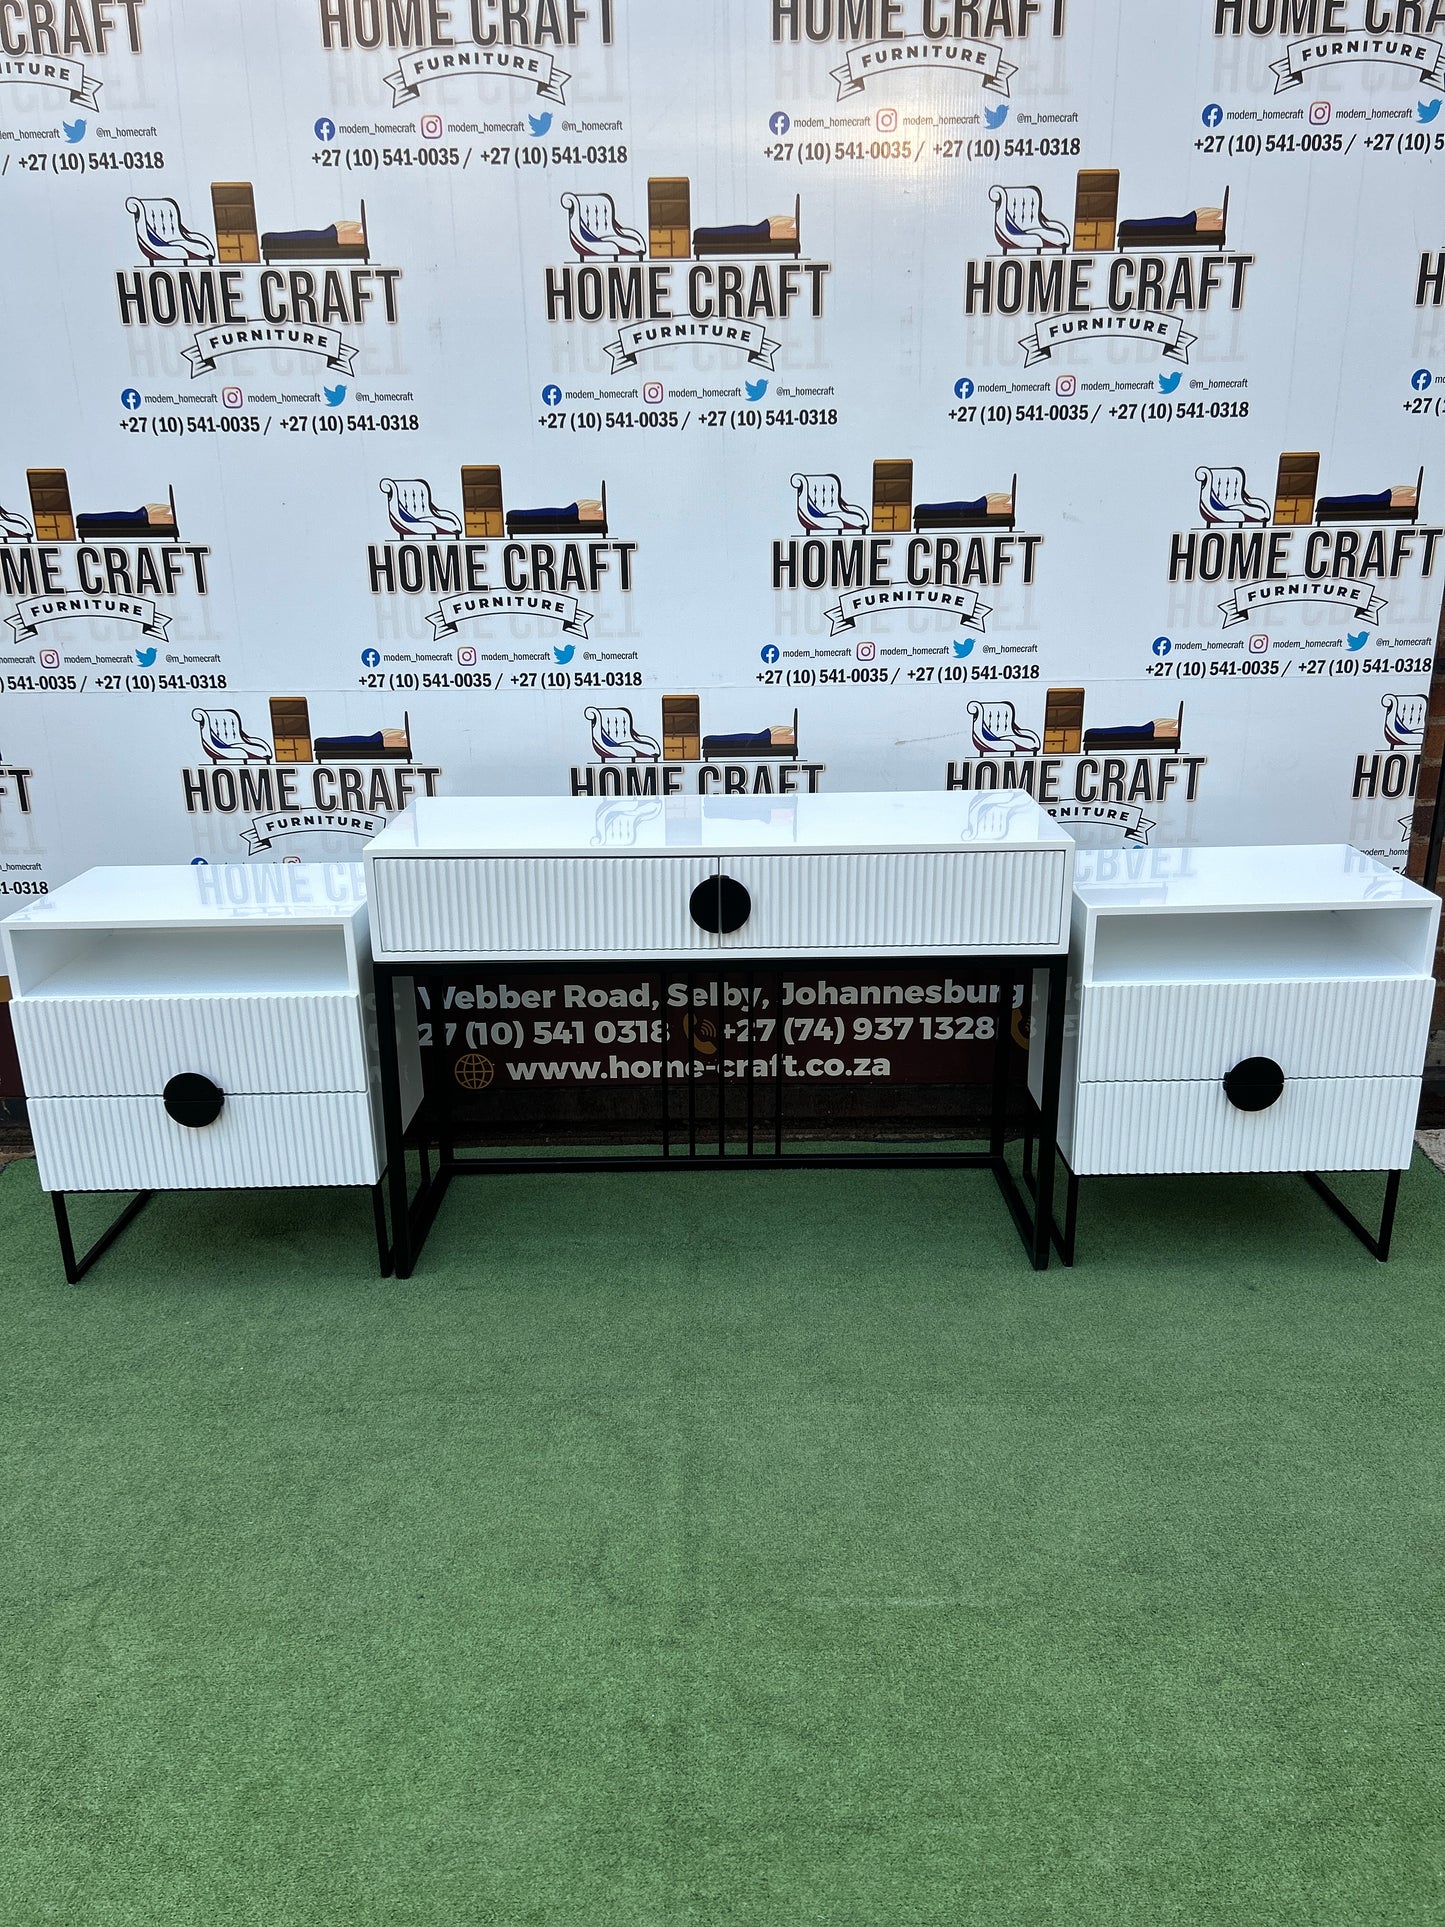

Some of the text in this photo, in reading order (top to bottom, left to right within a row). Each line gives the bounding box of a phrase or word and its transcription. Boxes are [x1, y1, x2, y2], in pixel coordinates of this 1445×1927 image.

[0, 0, 142, 55] CRAFT
[320, 0, 453, 47] HOME
[773, 0, 903, 40] HOME
[1215, 0, 1344, 34] HOME
[861, 44, 987, 68] FURNITURE
[1302, 40, 1427, 62] FURNITURE
[413, 52, 540, 73] FURNITURE
[562, 120, 623, 133] @m_homecraft
[1017, 112, 1078, 125] @m_homecraft
[96, 127, 157, 139] @m_homecraft
[764, 144, 793, 161] +27
[798, 143, 830, 164] (10)
[933, 140, 963, 157] +27
[967, 140, 1000, 161] (10)
[1004, 138, 1080, 156] 541-0318
[1195, 136, 1225, 152] +27
[1229, 135, 1261, 156] (10)
[1364, 134, 1394, 150] +27
[1398, 134, 1430, 154] (10)
[19, 154, 47, 170] +27
[52, 153, 85, 174] (10)
[89, 152, 164, 169] 541-0318
[312, 149, 341, 166] +27
[346, 149, 378, 170] (10)
[481, 147, 510, 164] +27
[515, 147, 547, 168] (10)
[552, 146, 627, 164] 541-0318
[546, 265, 828, 319] HOME CRAFT
[966, 256, 1252, 313] HOME CRAFT
[117, 270, 399, 324] HOME CRAFT
[633, 321, 752, 344] FURNITURE
[1049, 316, 1168, 338] FURNITURE
[209, 328, 329, 349] FURNITURE
[777, 386, 834, 397] @m_homecraft
[1190, 379, 1247, 390] @m_homecraft
[356, 392, 413, 403] @m_homecraft
[1403, 398, 1432, 413] +27
[539, 413, 566, 428] +27
[571, 413, 601, 432] (10)
[699, 411, 726, 426] +27
[731, 411, 761, 429] (10)
[766, 409, 837, 425] 541-0318
[949, 407, 976, 422] +27
[981, 406, 1011, 425] (10)
[1109, 404, 1137, 419] +27
[1141, 403, 1172, 422] (10)
[1176, 402, 1248, 418] 541-0318
[120, 417, 147, 432] +27
[152, 417, 183, 436] (10)
[280, 416, 307, 431] +27
[312, 416, 343, 435] (10)
[348, 415, 419, 431] 541-0318
[774, 537, 1041, 587] HOME CRAFT
[1169, 529, 1443, 580] HOME CRAFT
[77, 548, 208, 594] CRAFT
[368, 544, 635, 592] HOME CRAFT
[852, 591, 965, 610] FURNITURE
[1247, 584, 1361, 602] FURNITURE
[30, 599, 143, 617] FURNITURE
[452, 596, 566, 614] FURNITURE
[983, 644, 1037, 654] @m_homecraft
[1376, 637, 1431, 647] @m_homecraft
[166, 654, 221, 664] @m_homecraft
[583, 651, 638, 661] @m_homecraft
[756, 670, 782, 684] +27
[787, 670, 815, 686] (10)
[908, 667, 934, 681] +27
[938, 667, 967, 683] (10)
[971, 665, 1039, 680] 541-0318
[1146, 663, 1173, 676] +27
[1176, 662, 1206, 679] (10)
[1299, 660, 1326, 674] +27
[1329, 660, 1359, 676] (10)
[1363, 657, 1432, 673] 541-0318
[95, 676, 121, 689] +27
[126, 675, 155, 692] (10)
[159, 675, 226, 689] 541-0318
[359, 674, 385, 687] +27
[390, 674, 419, 691] (10)
[511, 673, 537, 686] +27
[541, 673, 570, 689] (10)
[575, 672, 642, 686] 541-0318
[183, 769, 299, 811] HOME
[1076, 758, 1204, 802] CRAFT
[267, 815, 374, 831] FURNITURE
[564, 983, 659, 1011] Road,
[667, 982, 769, 1012] Selby,
[782, 979, 1024, 1008] Johannesburg
[466, 1020, 524, 1048] (10)
[533, 1020, 584, 1044] 541
[594, 1020, 670, 1044] 0318
[784, 1016, 845, 1045] (74)
[852, 1016, 914, 1041] 937
[919, 1016, 995, 1041] 1328
